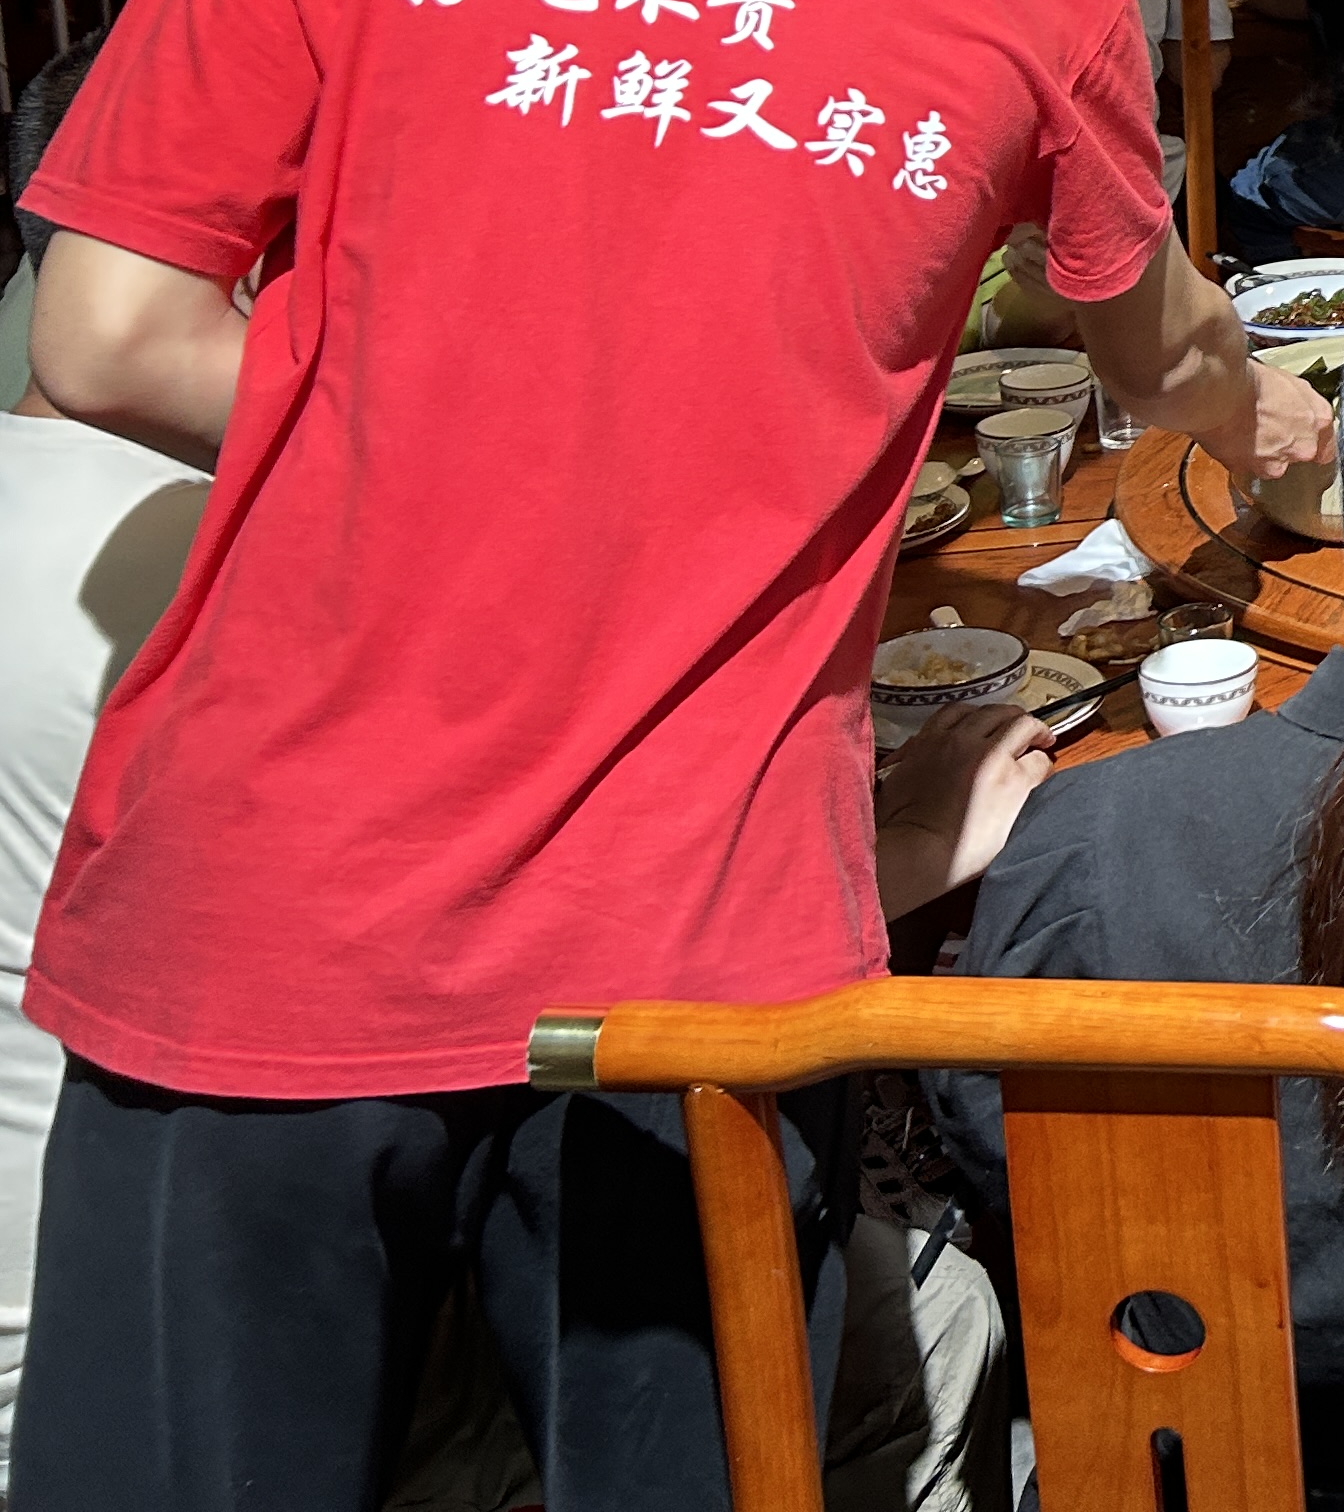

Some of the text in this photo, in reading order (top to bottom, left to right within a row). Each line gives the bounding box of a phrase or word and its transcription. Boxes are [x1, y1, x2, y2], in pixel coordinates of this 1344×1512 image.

[485, 33, 952, 200] 新鲜又实惠
